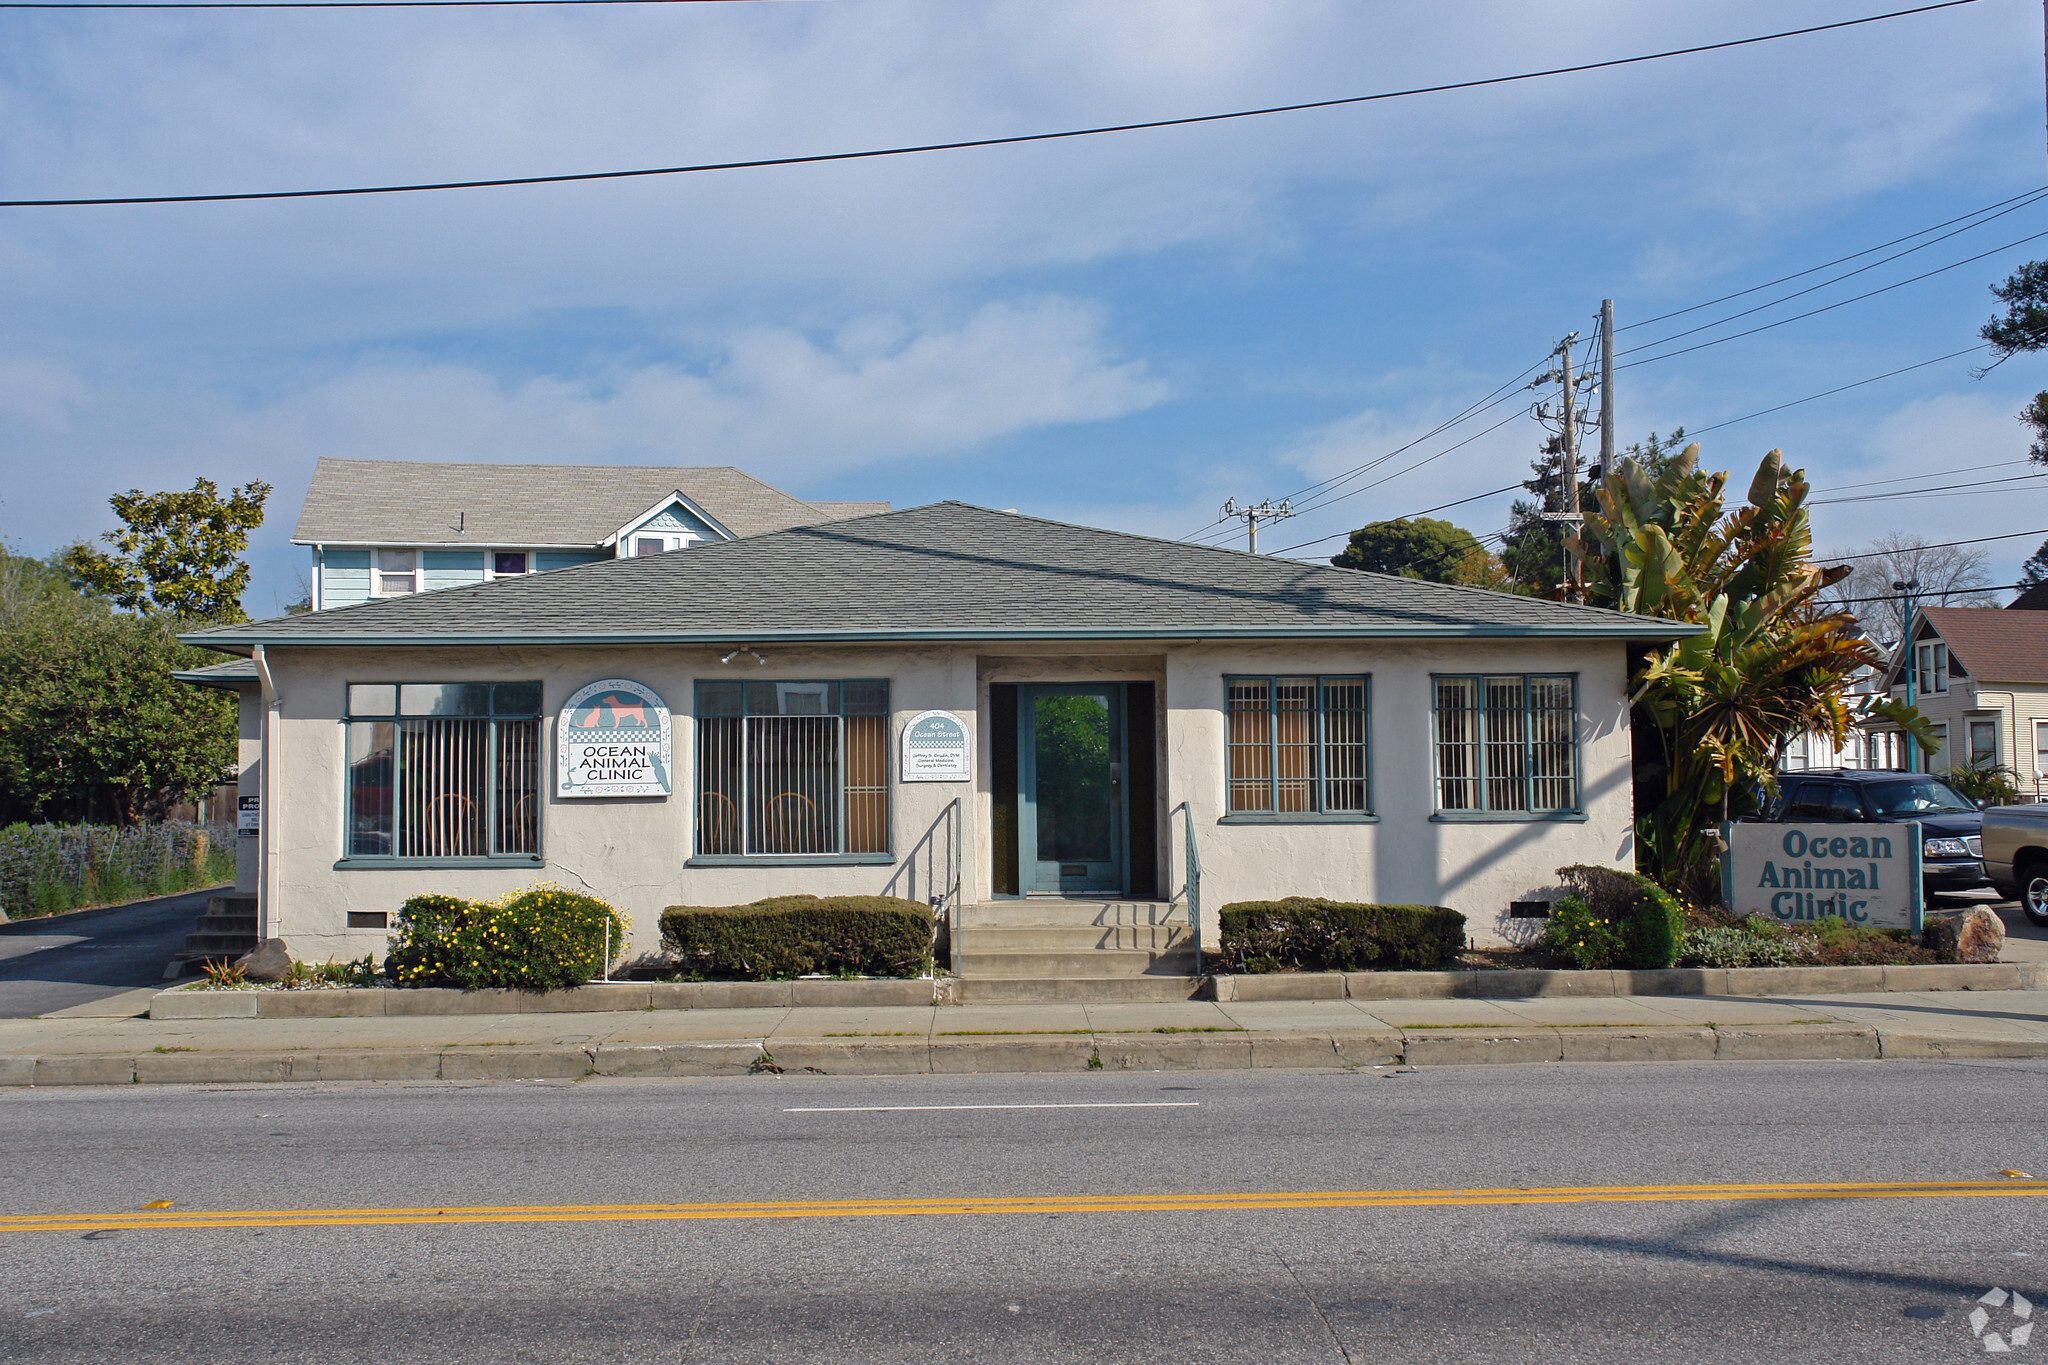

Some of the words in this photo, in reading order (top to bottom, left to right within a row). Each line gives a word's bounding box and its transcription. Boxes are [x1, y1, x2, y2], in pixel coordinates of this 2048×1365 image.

[930, 722, 945, 730] 404
[914, 730, 936, 738] Ocean
[937, 730, 960, 738] Street
[583, 746, 646, 757] OCEAN
[579, 757, 650, 768] ANIMAL
[587, 769, 643, 780] CLINIC
[1783, 830, 1893, 858] Ocean
[1758, 860, 1880, 890] Animal
[1770, 891, 1869, 922] Clinic
